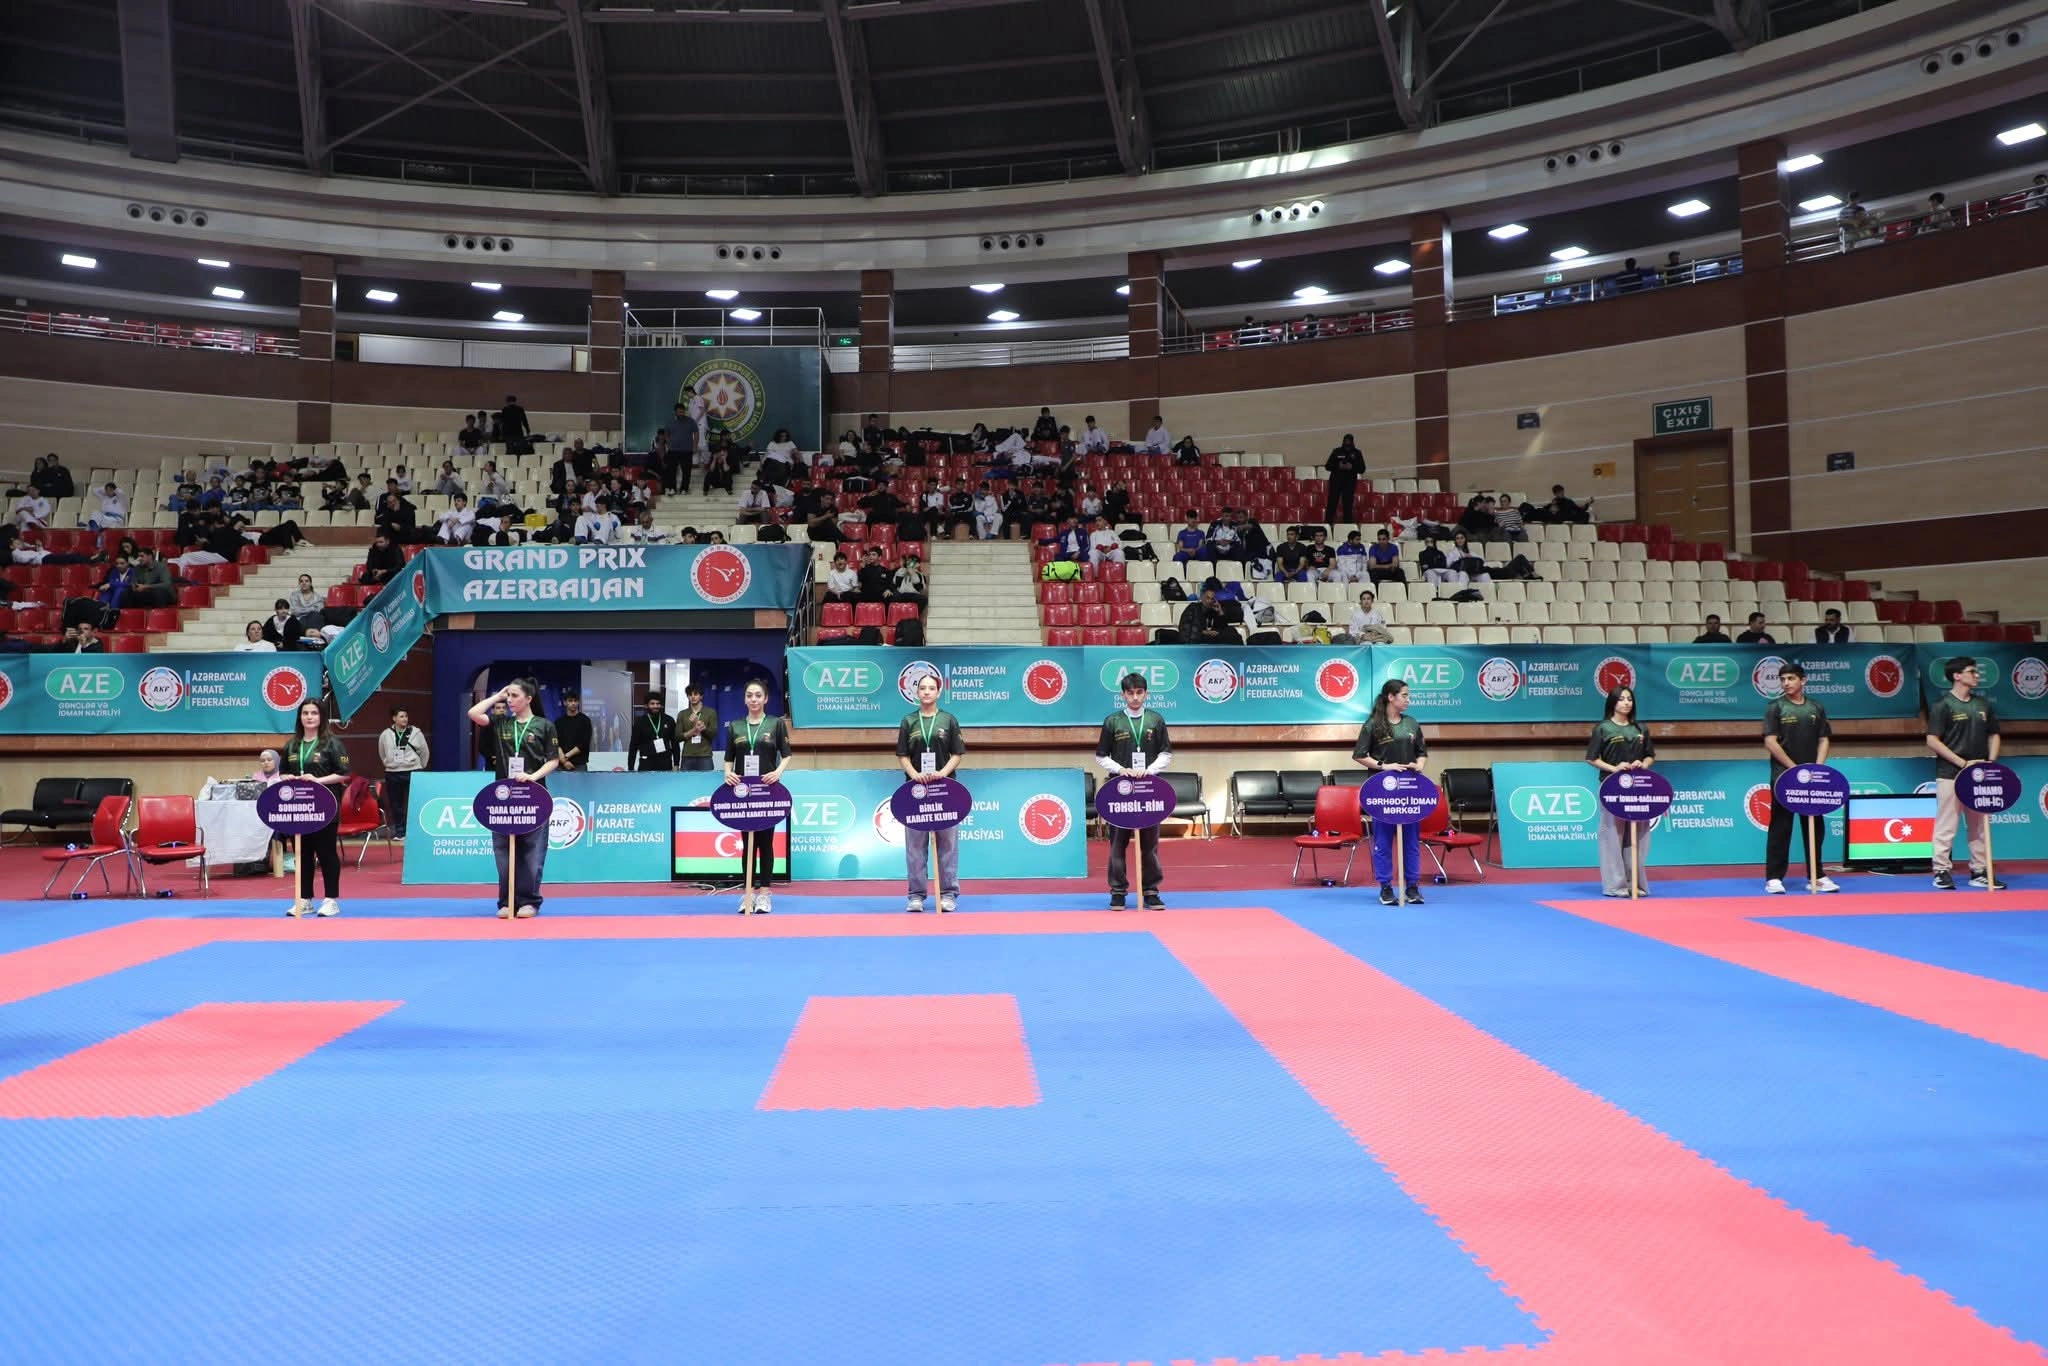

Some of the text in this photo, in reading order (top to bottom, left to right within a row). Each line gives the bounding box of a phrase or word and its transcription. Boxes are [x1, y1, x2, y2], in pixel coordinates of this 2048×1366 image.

[1663, 405, 1702, 418] ÇIXIŞ
[1666, 416, 1697, 428] EXIT
[464, 548, 646, 572] GRAND PRIX
[464, 578, 643, 602] AZERBAIJAN
[341, 640, 364, 676] AZE
[952, 666, 1006, 674] AZƏRBAYCAN
[1246, 664, 1300, 673] AZƏRBAYCAN
[1528, 663, 1578, 672] AZƏRBAYCAN
[1680, 663, 1726, 681] AZE
[192, 673, 246, 681] AZƏRBAYCAN
[819, 668, 868, 688] AZE
[1402, 664, 1450, 684] AZE
[60, 674, 110, 694] AZE
[952, 679, 984, 688] KARATE
[1246, 677, 1278, 686] KARATE
[1528, 675, 1558, 684] KARATE
[192, 686, 224, 694] KARATE
[952, 690, 1009, 700] FEDERASİYASI
[1246, 688, 1302, 698] FEDERASİYASI
[1528, 686, 1582, 696] FEDERASİYASI
[192, 696, 250, 706] FEDERASİYASI
[1973, 784, 2003, 796] DİNAMO
[1674, 791, 1726, 800] ZƏRBAYCAN
[1366, 796, 1436, 806] SƏRHƏDÇİ İDMAN
[1528, 794, 1582, 815] AZE
[597, 804, 661, 814] AZƏRBAYCAN
[919, 803, 943, 812] BİRLİK
[1108, 800, 1164, 813] TƏHSİL-RİM
[1384, 806, 1420, 814] MƏRKƏZİ
[1670, 804, 1704, 814] KARATE
[437, 805, 477, 828] AZ
[906, 814, 933, 823] KARATE
[934, 812, 958, 820] KLUBU
[596, 818, 634, 828] KARATE
[1672, 816, 1734, 828] FEDERASİYASI
[596, 831, 664, 843] FEDERASİYASI
